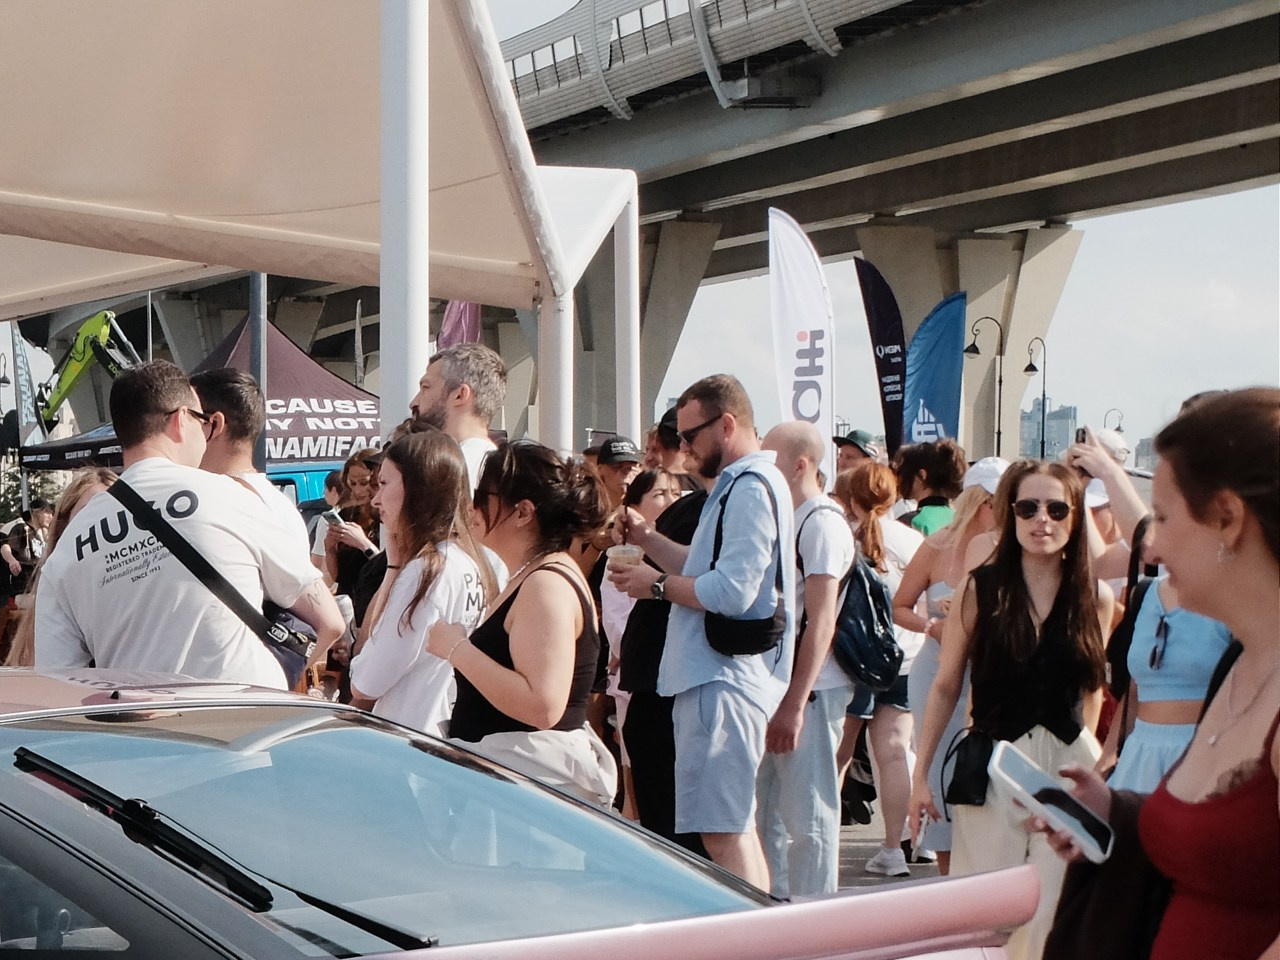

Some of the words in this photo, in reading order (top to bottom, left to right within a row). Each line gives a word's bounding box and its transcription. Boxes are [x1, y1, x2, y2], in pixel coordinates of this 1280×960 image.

[266, 398, 378, 414] CAUSE
[305, 417, 381, 430] NOT
[109, 536, 161, 563] MCMXC
[105, 555, 140, 574] REGISTERED
[131, 572, 148, 583] SINCE
